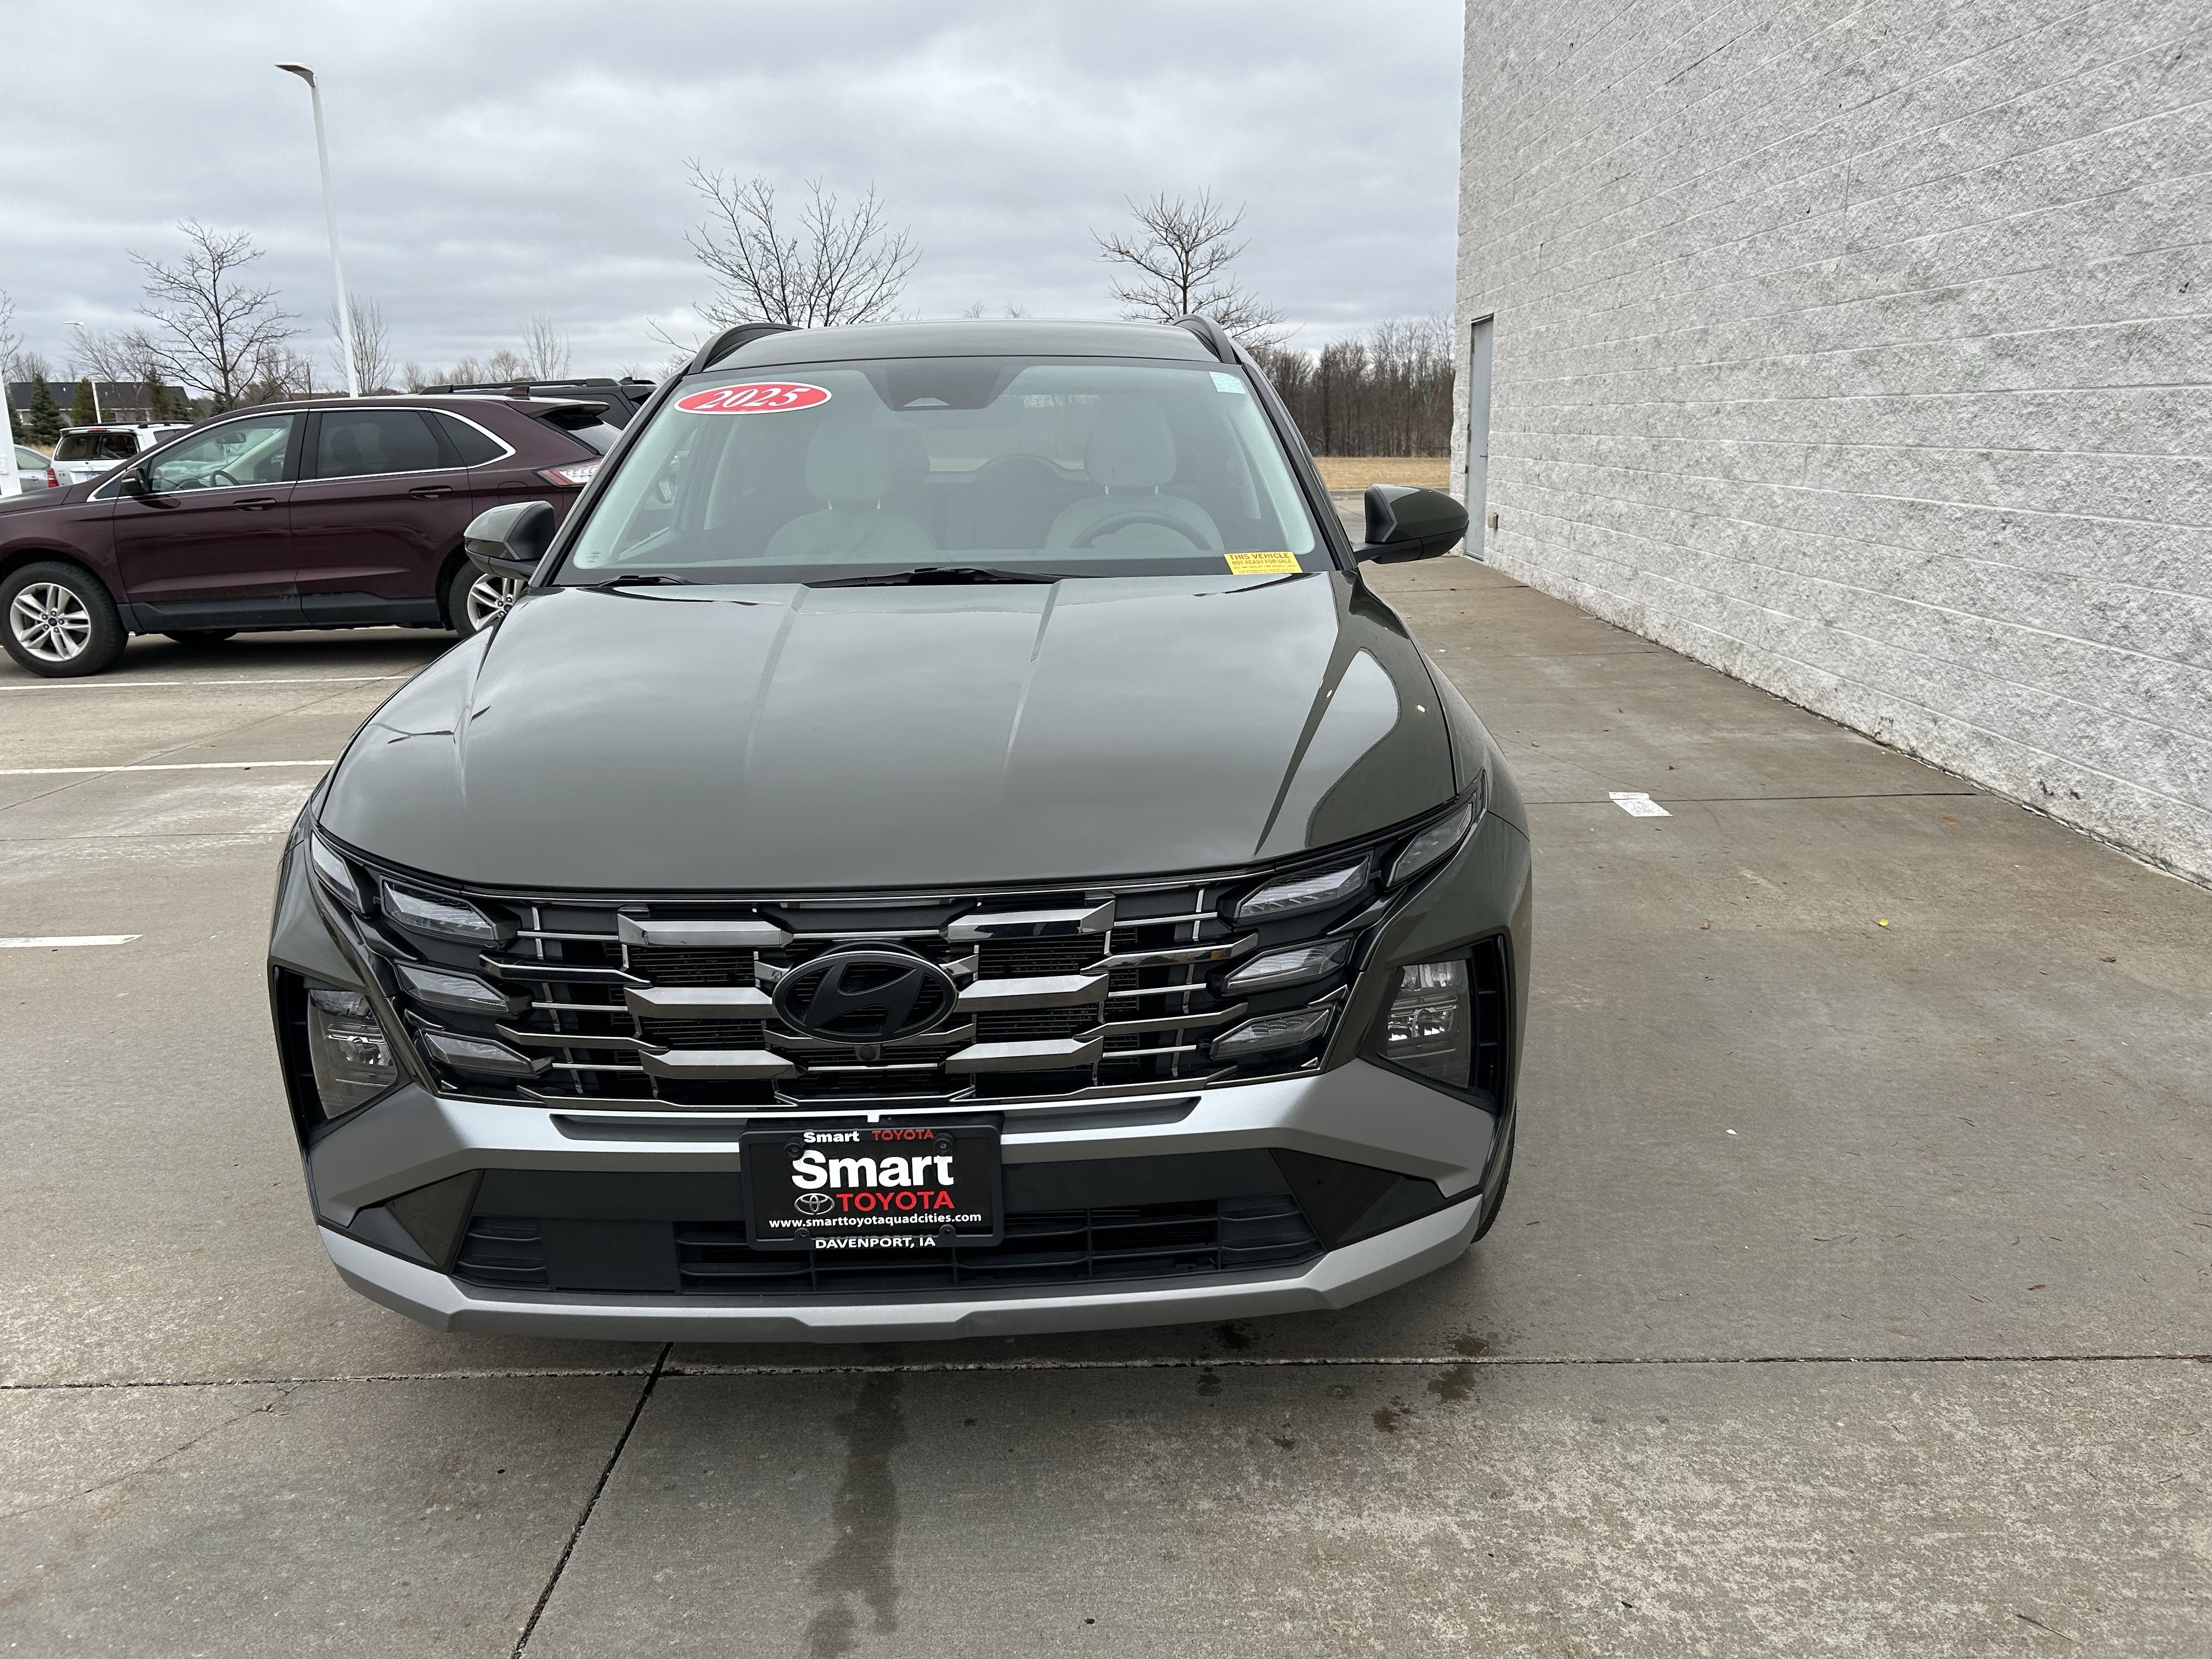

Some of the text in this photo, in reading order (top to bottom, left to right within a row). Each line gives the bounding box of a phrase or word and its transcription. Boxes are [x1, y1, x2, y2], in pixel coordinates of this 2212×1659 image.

[693, 388, 811, 409] 2025
[804, 1129, 934, 1143] Smart TOYOTA
[792, 1150, 955, 1189] Smart
[836, 1190, 955, 1212] TOYOTA
[769, 1212, 982, 1228] www.smarttoyotaquadcities.com
[815, 1237, 936, 1249] DAVENPORT, IA
